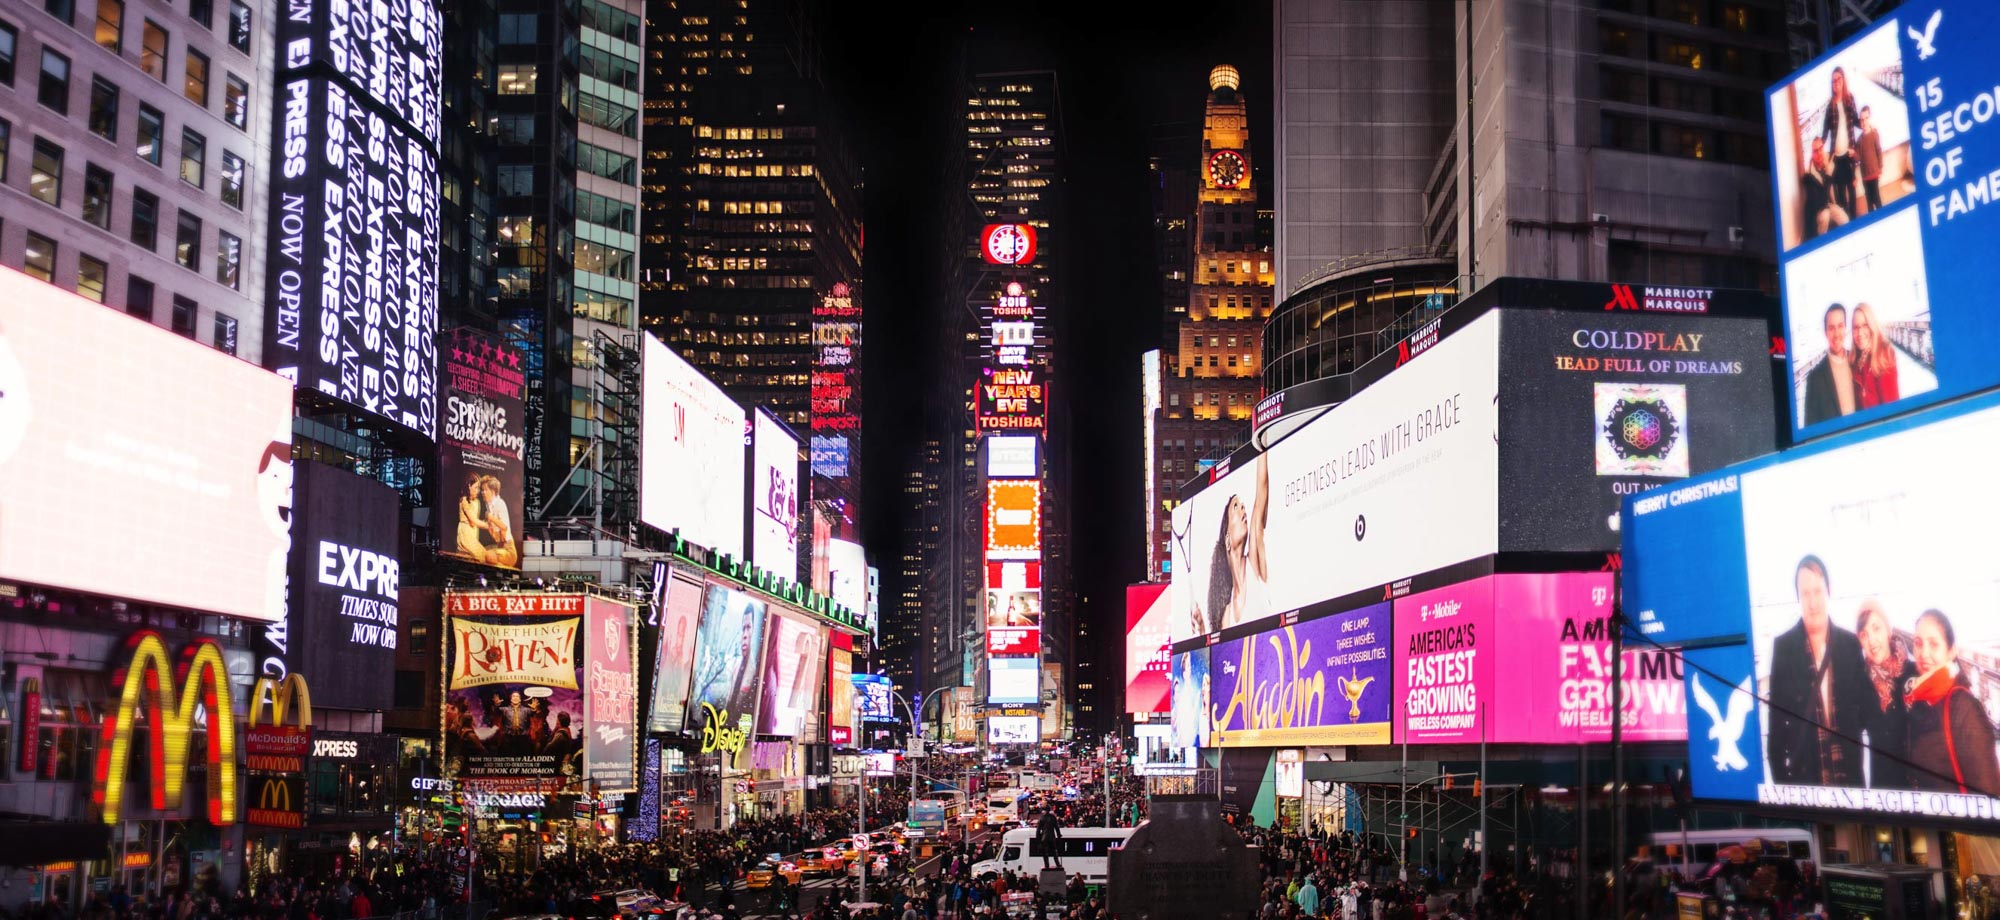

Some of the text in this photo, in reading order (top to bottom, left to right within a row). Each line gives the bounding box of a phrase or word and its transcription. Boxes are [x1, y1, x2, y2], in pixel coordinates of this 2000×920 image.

[1915, 77, 1943, 113] 15
[1920, 85, 2000, 150] SECO
[1925, 146, 1963, 187] OF
[1929, 169, 2000, 227] FAME
[277, 192, 304, 350] NOW OPEN
[319, 179, 344, 366] EXPRESS
[363, 175, 385, 353] EXPRESS
[1645, 287, 1713, 300] MARRIOTT
[1645, 299, 1706, 311] MARQUIS
[403, 227, 422, 399] EXPRESS
[993, 307, 1033, 315] TOSHIBA
[1411, 318, 1442, 344] MARRIOTT
[1572, 329, 1704, 352] COLDPLAY
[1000, 347, 1026, 355] DAYS
[1411, 333, 1438, 356] MARQUIS
[993, 371, 1034, 384] NEW
[1604, 358, 1645, 372] FULL
[1649, 360, 1671, 373] OF
[1675, 361, 1742, 374] DREAMS
[984, 385, 1041, 398] YEAR'S
[1257, 392, 1285, 414] MARRIOTT
[447, 396, 507, 429] SPRING
[997, 398, 1028, 412] EVE
[1257, 405, 1281, 425] MARQUIS
[980, 416, 1043, 428] TOSHIBA
[1285, 459, 1337, 507] GREATNESS
[1341, 439, 1375, 480] LEADS
[1381, 419, 1411, 460] WITH
[1416, 393, 1461, 442] GRACE
[1612, 482, 1639, 494] OUT
[1633, 474, 1738, 517] MERRY CHRISTMAS!
[714, 547, 853, 626] 1540 BROADWAY
[341, 595, 379, 621] TIMES
[469, 598, 501, 613] BIG,
[507, 599, 537, 611] FAT
[351, 623, 380, 646] NOW
[470, 625, 561, 638] SOMETHING
[1342, 620, 1353, 632] ONE
[1336, 637, 1353, 651] THREE
[1409, 623, 1475, 656] AMERICA'S
[1327, 654, 1348, 667] INFINITE
[1408, 650, 1476, 687] FASTEST
[1212, 625, 1325, 732] Aladdin
[1408, 684, 1476, 717] GROWING
[1408, 713, 1475, 730] WIRELESS COMPANY
[247, 733, 307, 745] McDonald's
[701, 701, 746, 769] Disney
[312, 739, 358, 758] XPRESS
[470, 767, 555, 775] THE BOOK OF MORMON
[411, 777, 454, 792] GIFTS
[1759, 785, 1856, 810] AMERICAN
[1861, 788, 1923, 813] EAGLE
